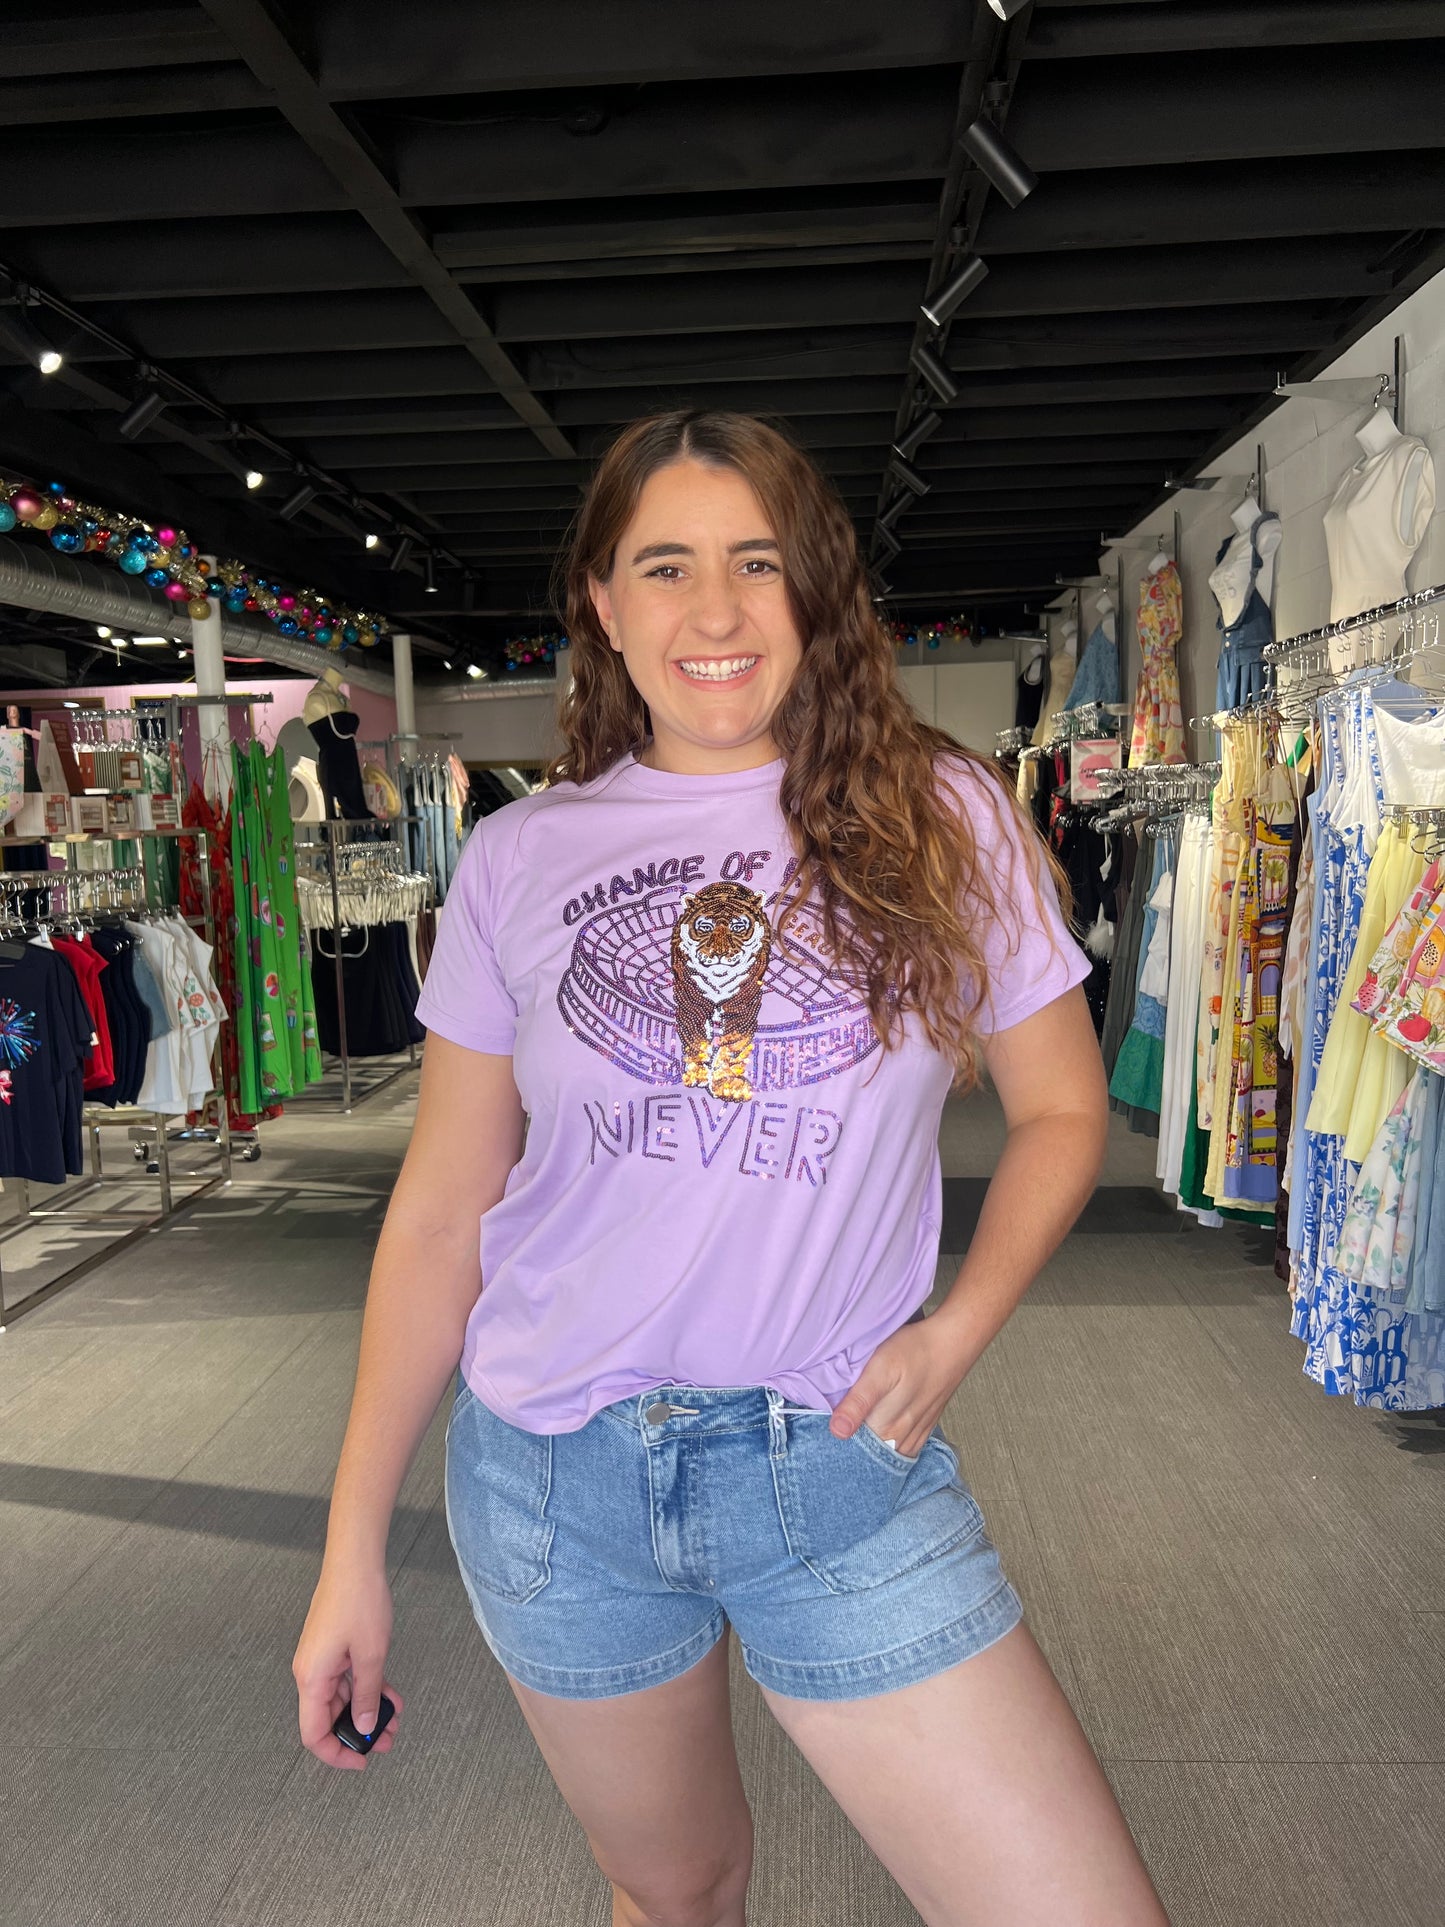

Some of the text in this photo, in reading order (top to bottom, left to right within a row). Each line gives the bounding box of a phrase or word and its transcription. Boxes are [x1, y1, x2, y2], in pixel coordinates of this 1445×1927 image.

[563, 850, 772, 926] CHANCE OF
[782, 912, 837, 959] GEAU
[583, 1094, 842, 1187] NEVER
